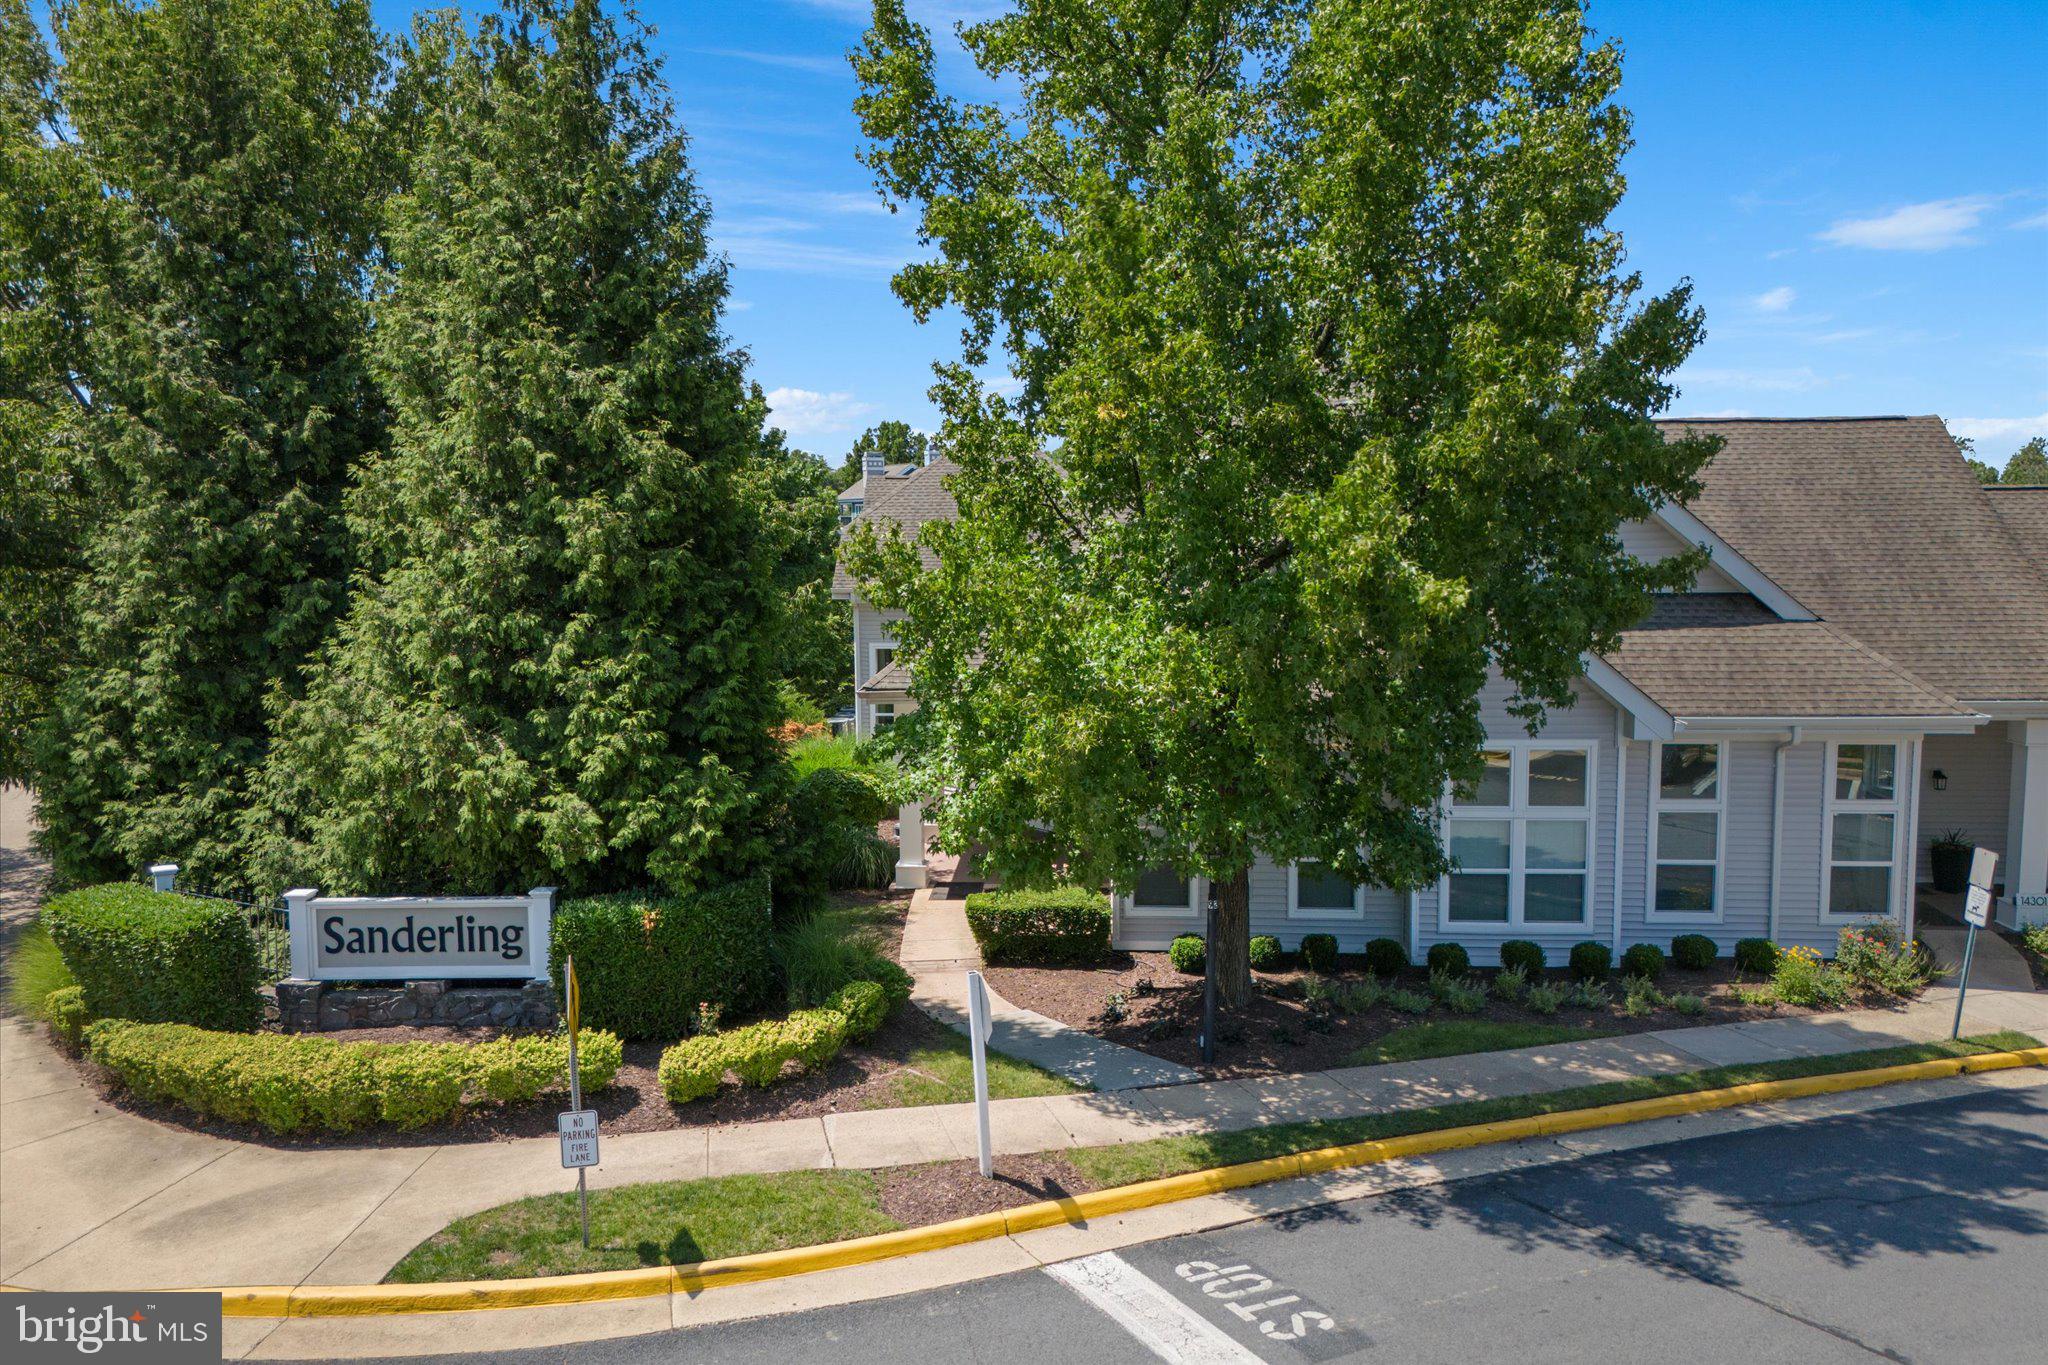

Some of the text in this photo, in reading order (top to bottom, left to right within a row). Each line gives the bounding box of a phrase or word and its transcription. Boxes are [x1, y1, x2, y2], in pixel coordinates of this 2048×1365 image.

[323, 915, 524, 960] Sanderling
[573, 1117, 583, 1127] NO
[563, 1129, 595, 1141] PARKING
[571, 1143, 588, 1152] FIRE
[570, 1153, 590, 1162] LANE
[1175, 1261, 1334, 1340] STOP
